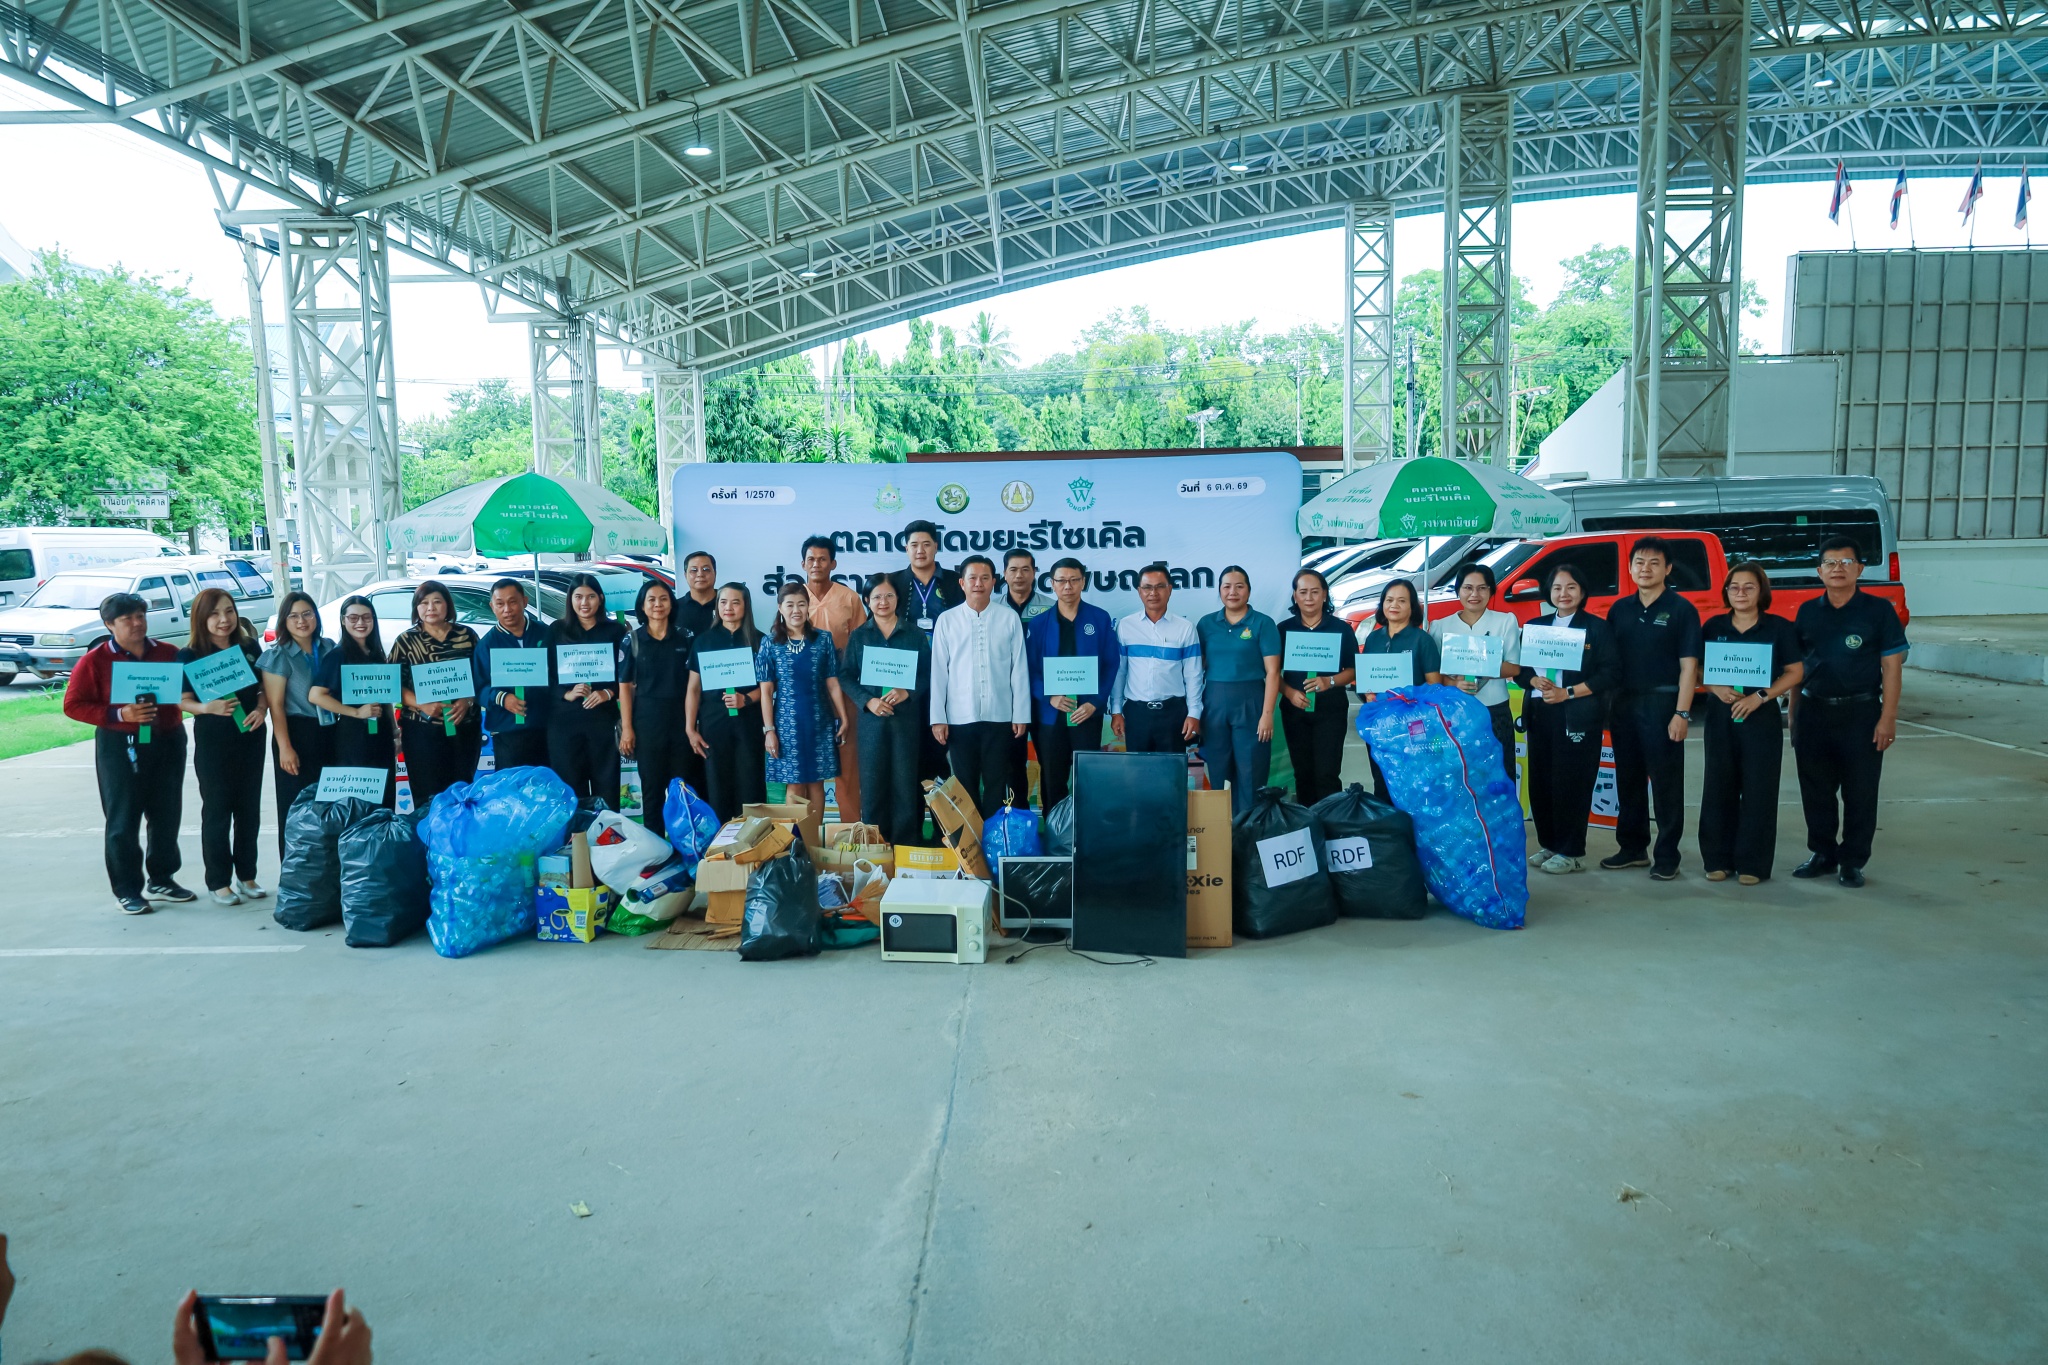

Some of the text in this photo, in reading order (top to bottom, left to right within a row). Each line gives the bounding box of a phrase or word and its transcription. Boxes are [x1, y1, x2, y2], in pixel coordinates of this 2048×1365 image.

[1180, 481, 1200, 493] วันที่
[1206, 484, 1212, 492] 6
[1237, 482, 1248, 490] 69
[1411, 484, 1461, 493] ตลาดนัด
[711, 487, 775, 500] ครั้งที่ 1/2570
[1404, 493, 1471, 503] ขยะรีไซเคิล
[1065, 497, 1096, 512] WONGPANIT
[500, 511, 568, 520] ขยะรีไซเคิล
[1422, 516, 1479, 528] วงษ์พาณิชย์
[1538, 649, 1564, 659] พิษณุโลก
[1723, 653, 1753, 663] สำนักงาน
[194, 655, 241, 681] สำนักงานท้องถิ่น
[427, 665, 456, 675] สำนักงาน
[1708, 665, 1761, 675] สรรพสามิตภาคที่
[200, 668, 246, 691] จังหวัดพิษณุโลก
[351, 672, 391, 682] โรงพยาบาล
[418, 670, 468, 687] สรรพสามิตพื้นที่
[574, 670, 599, 679] พิษณุโลก
[136, 683, 160, 692] พิษณุโลก
[351, 686, 392, 697] พุทธชินราช
[431, 687, 459, 697] พิษณุโลก
[326, 774, 380, 784] จวนผู้ว่าราชการ
[323, 785, 379, 796] จังหวัดพิษณุโลก
[1273, 846, 1306, 870] RDF
[1330, 846, 1366, 866] RDF
